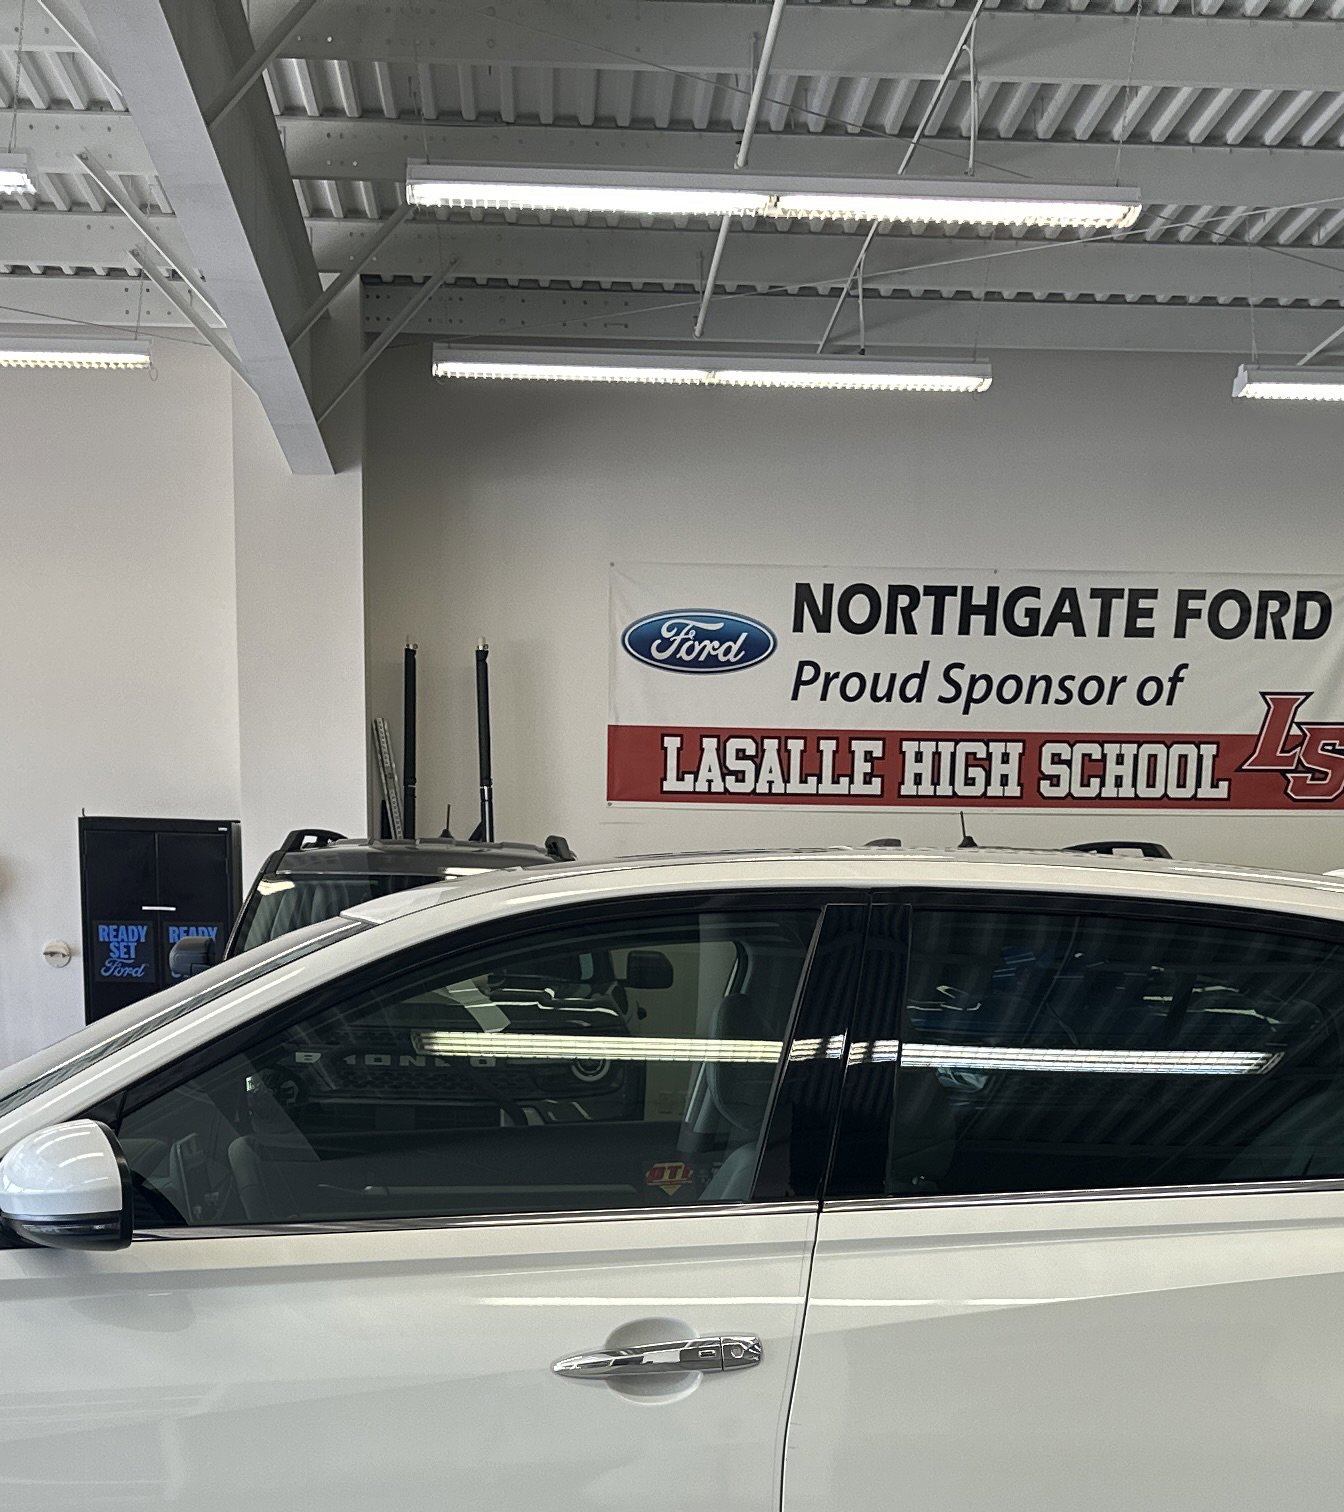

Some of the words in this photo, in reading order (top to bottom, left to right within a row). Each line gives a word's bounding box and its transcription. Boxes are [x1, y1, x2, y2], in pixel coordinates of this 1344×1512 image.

[792, 582, 1159, 639] NORTHGATE
[1173, 588, 1333, 641] FORD
[649, 618, 748, 666] Ford
[790, 660, 930, 704] Proud
[937, 662, 1128, 716] Sponsor
[1136, 662, 1189, 707] of
[660, 733, 886, 798] LASALLE
[899, 739, 1031, 800] HIGH
[1037, 741, 1232, 801] SCHOOL
[98, 924, 148, 942] READY
[109, 942, 137, 959] SET
[100, 958, 146, 977] Ford
